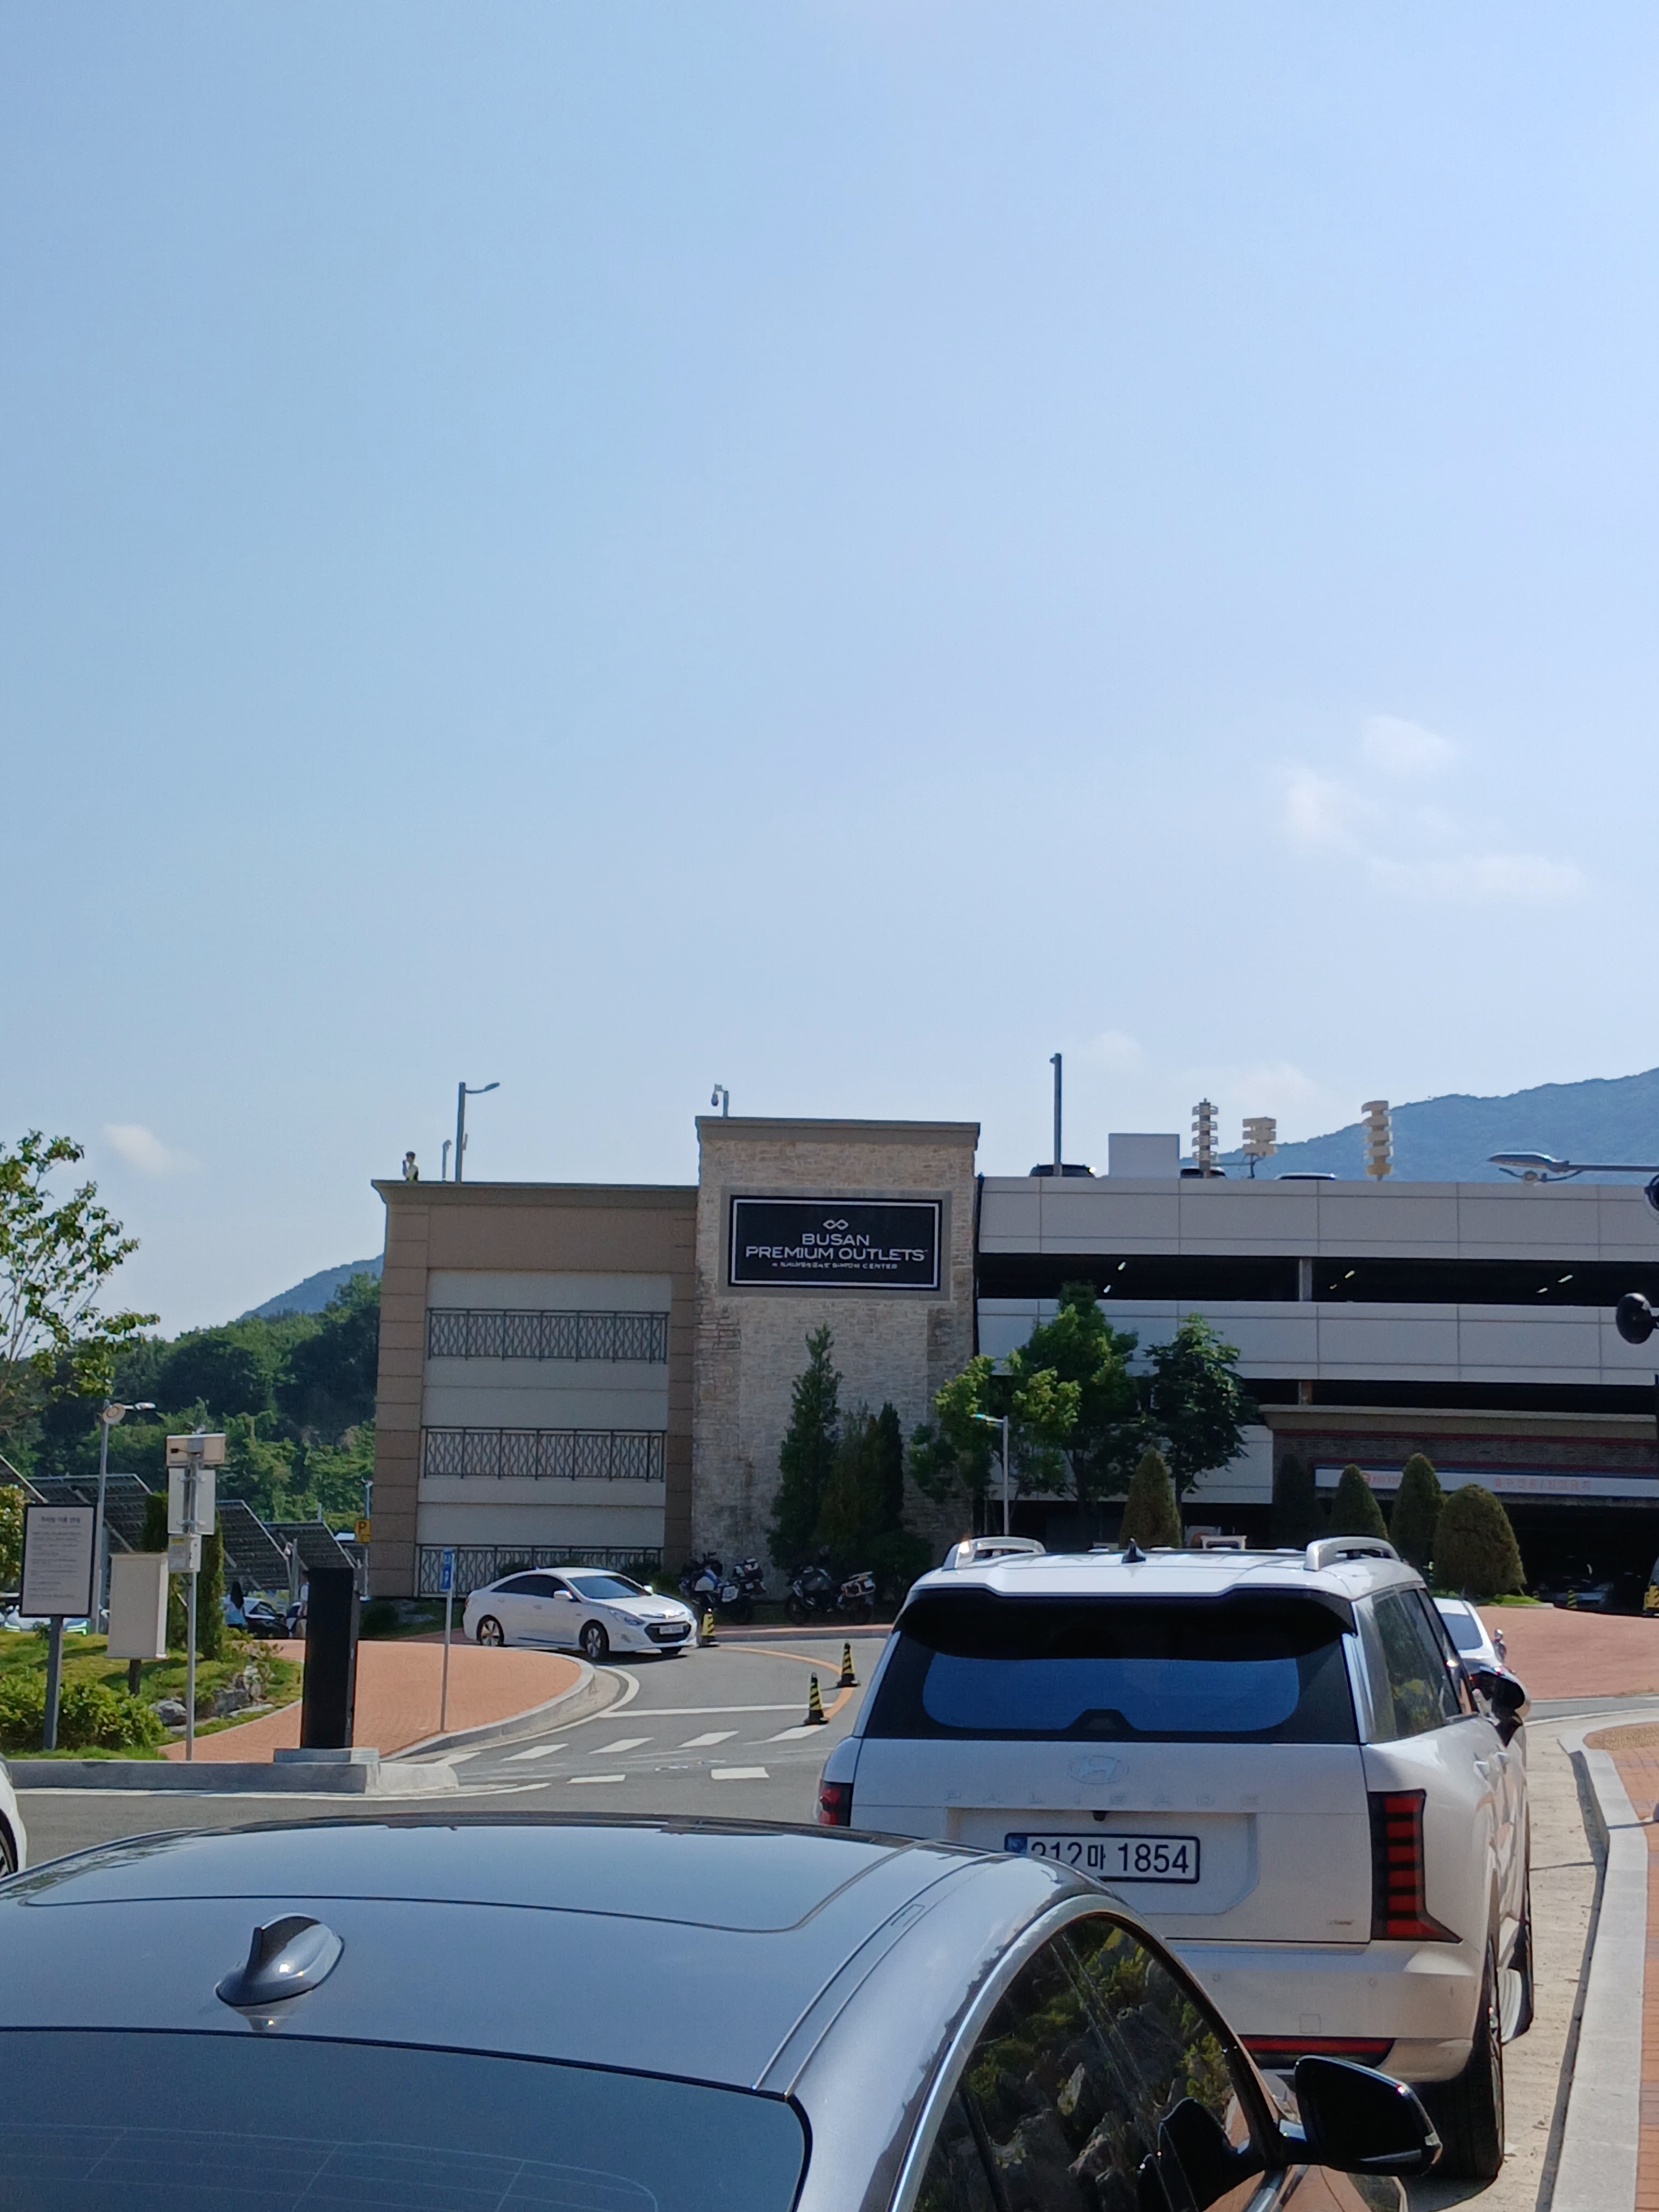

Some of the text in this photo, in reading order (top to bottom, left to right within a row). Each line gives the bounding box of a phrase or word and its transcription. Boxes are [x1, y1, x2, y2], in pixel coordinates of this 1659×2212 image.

[802, 1233, 870, 1246] BUSAN
[745, 1246, 925, 1261] PREMIUM OUTLETS
[358, 1521, 367, 1535] P
[1117, 1843, 1189, 1873] 1854
